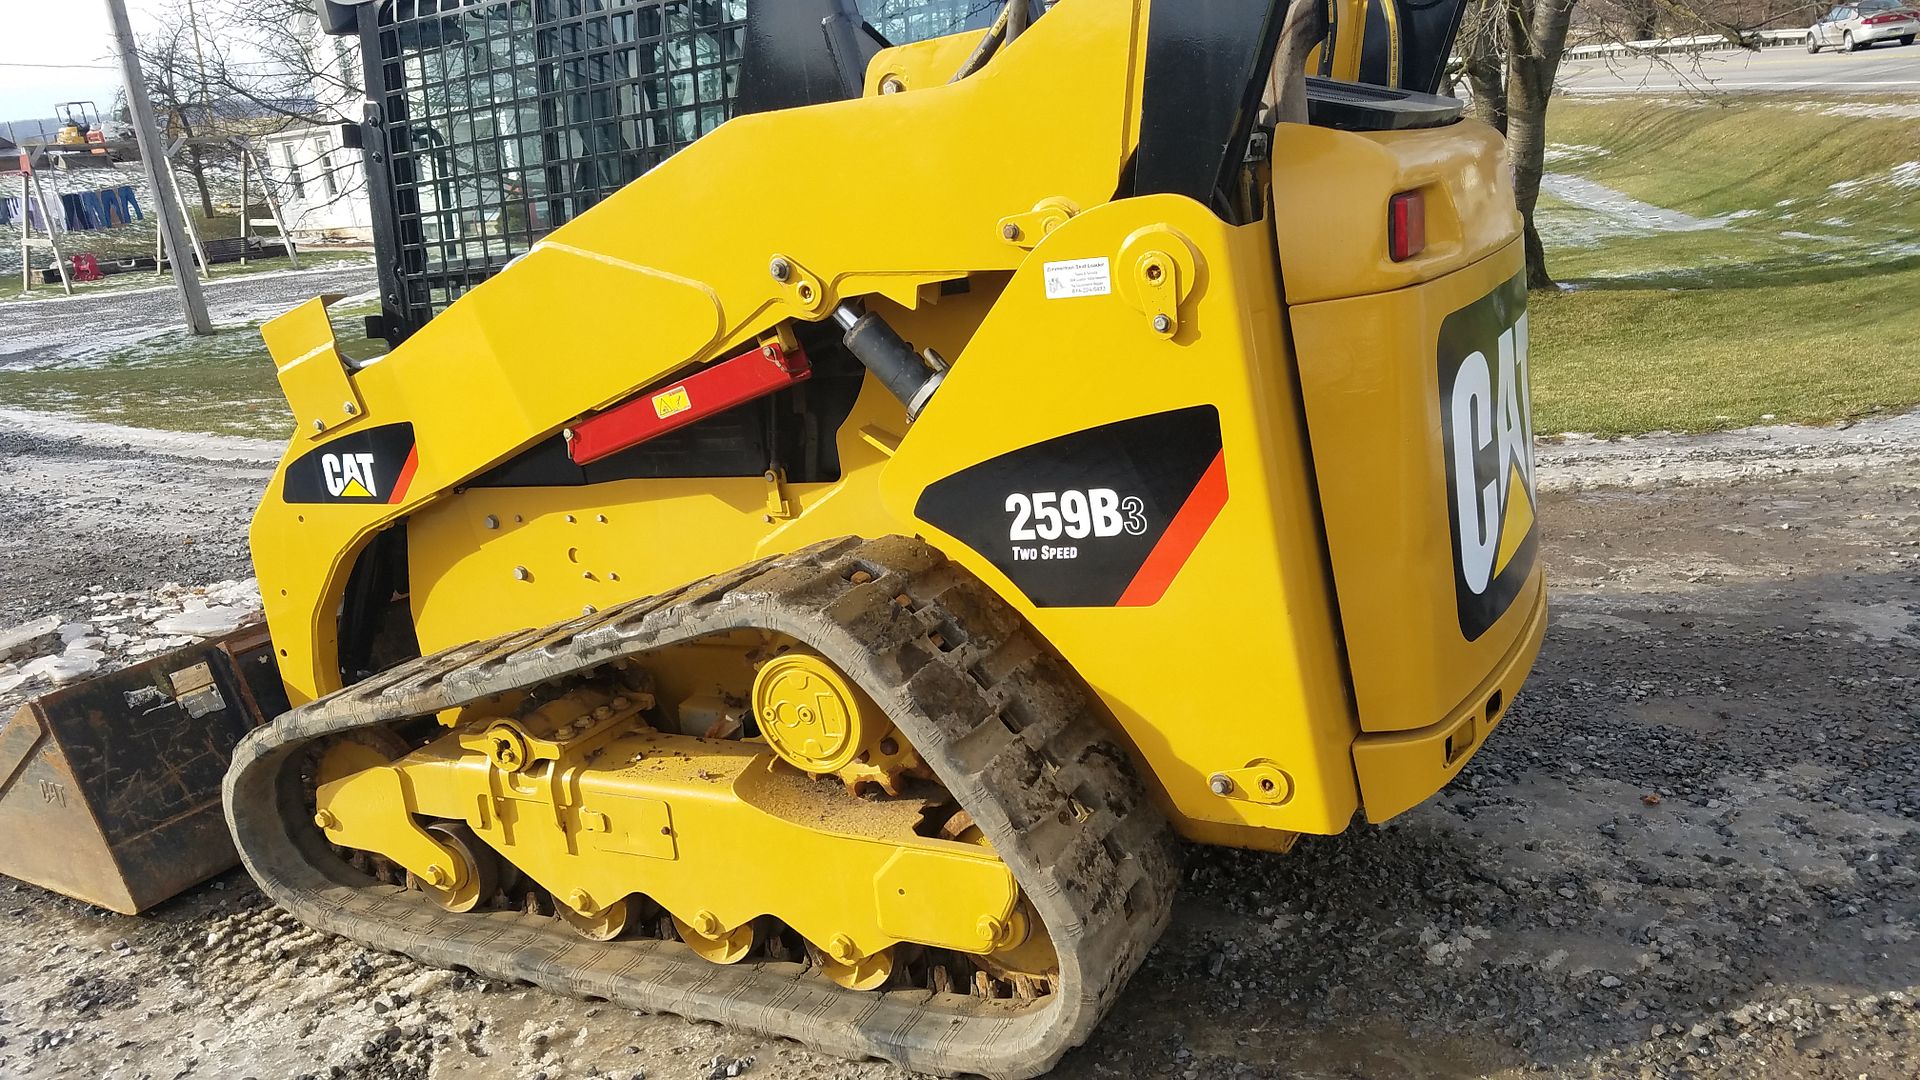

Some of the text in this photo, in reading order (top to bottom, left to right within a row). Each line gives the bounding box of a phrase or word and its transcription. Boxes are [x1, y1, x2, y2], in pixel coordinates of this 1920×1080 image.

[321, 453, 377, 497] CAT
[1005, 488, 1148, 541] 259B3
[39, 779, 67, 809] CAT
